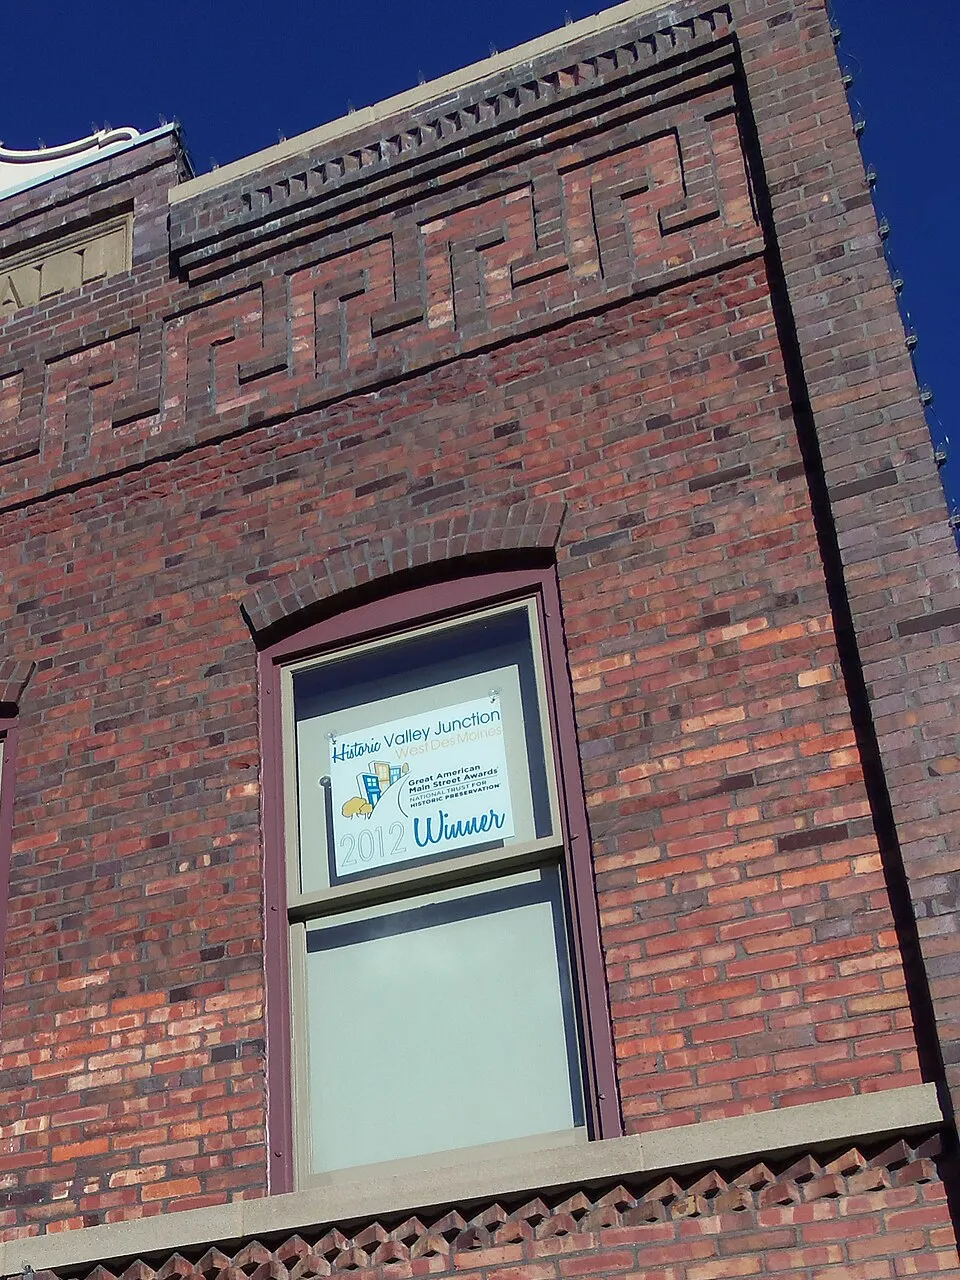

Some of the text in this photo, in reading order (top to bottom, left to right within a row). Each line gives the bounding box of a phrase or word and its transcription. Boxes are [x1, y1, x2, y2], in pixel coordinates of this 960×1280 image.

[332, 709, 500, 763] Historic Valley Junction
[396, 726, 502, 760] West Des Moines
[408, 765, 480, 786] Great American
[409, 768, 498, 794] Main Street Awards
[410, 781, 487, 802] NATIONAL TRUST FOR
[410, 784, 500, 808] HISTORIC PRESERVATION
[340, 809, 505, 867] 2012 Winner
